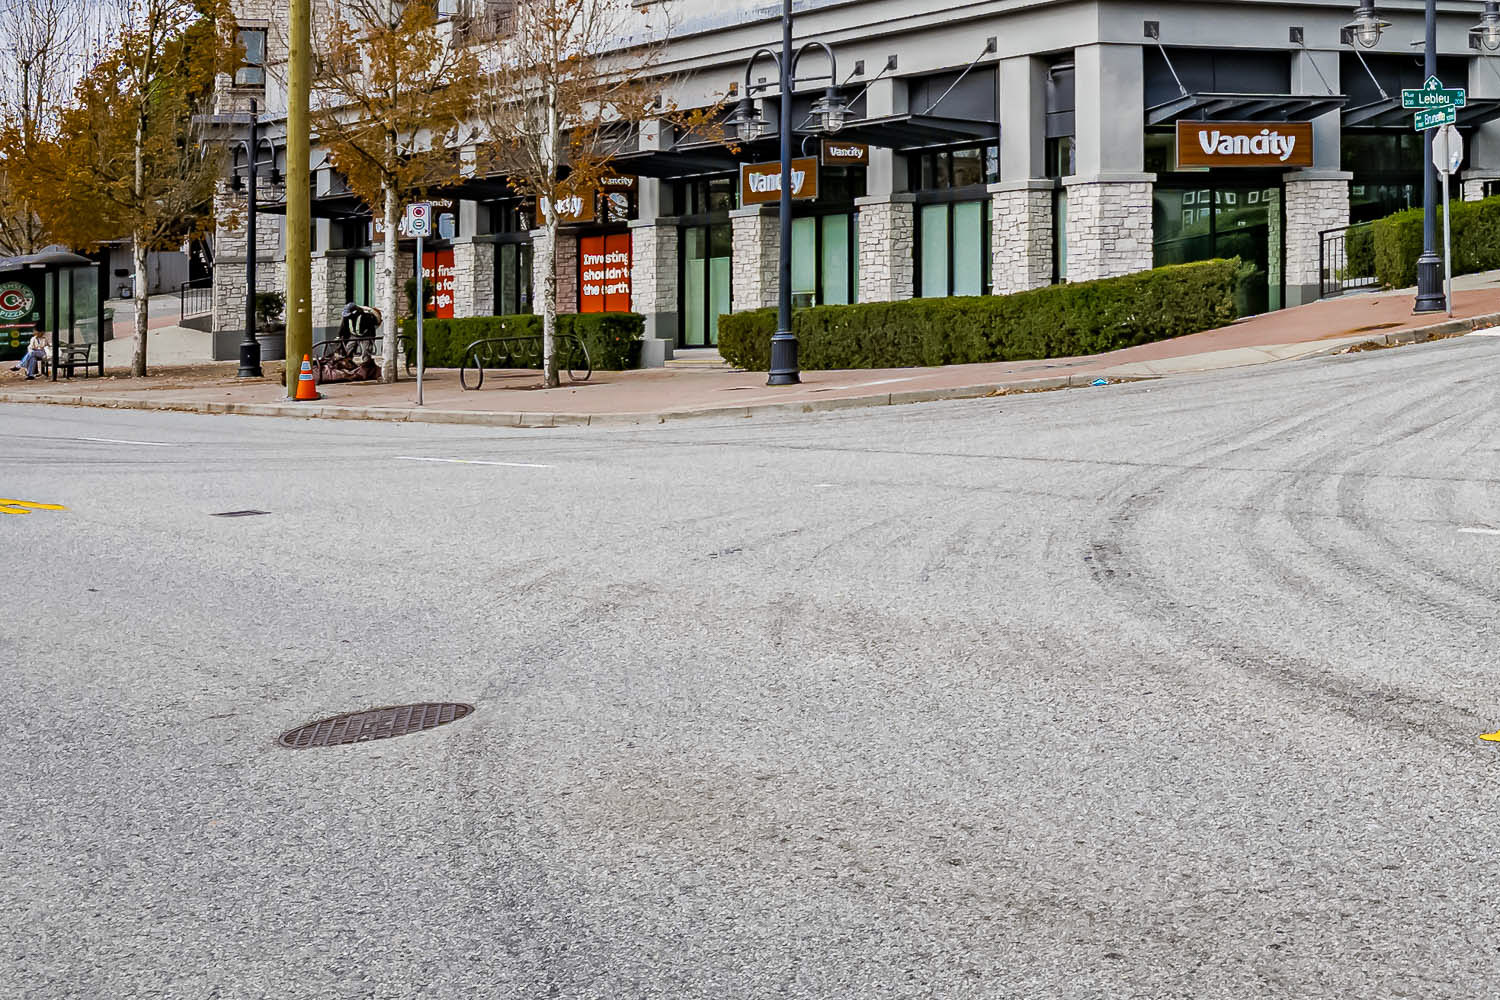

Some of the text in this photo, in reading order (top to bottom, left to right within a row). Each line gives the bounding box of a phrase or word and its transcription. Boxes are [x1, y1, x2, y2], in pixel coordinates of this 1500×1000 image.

[1418, 92, 1450, 104] Lebleu
[1198, 128, 1296, 161] Vancity
[829, 146, 863, 158] Vancity
[583, 283, 600, 296] the
